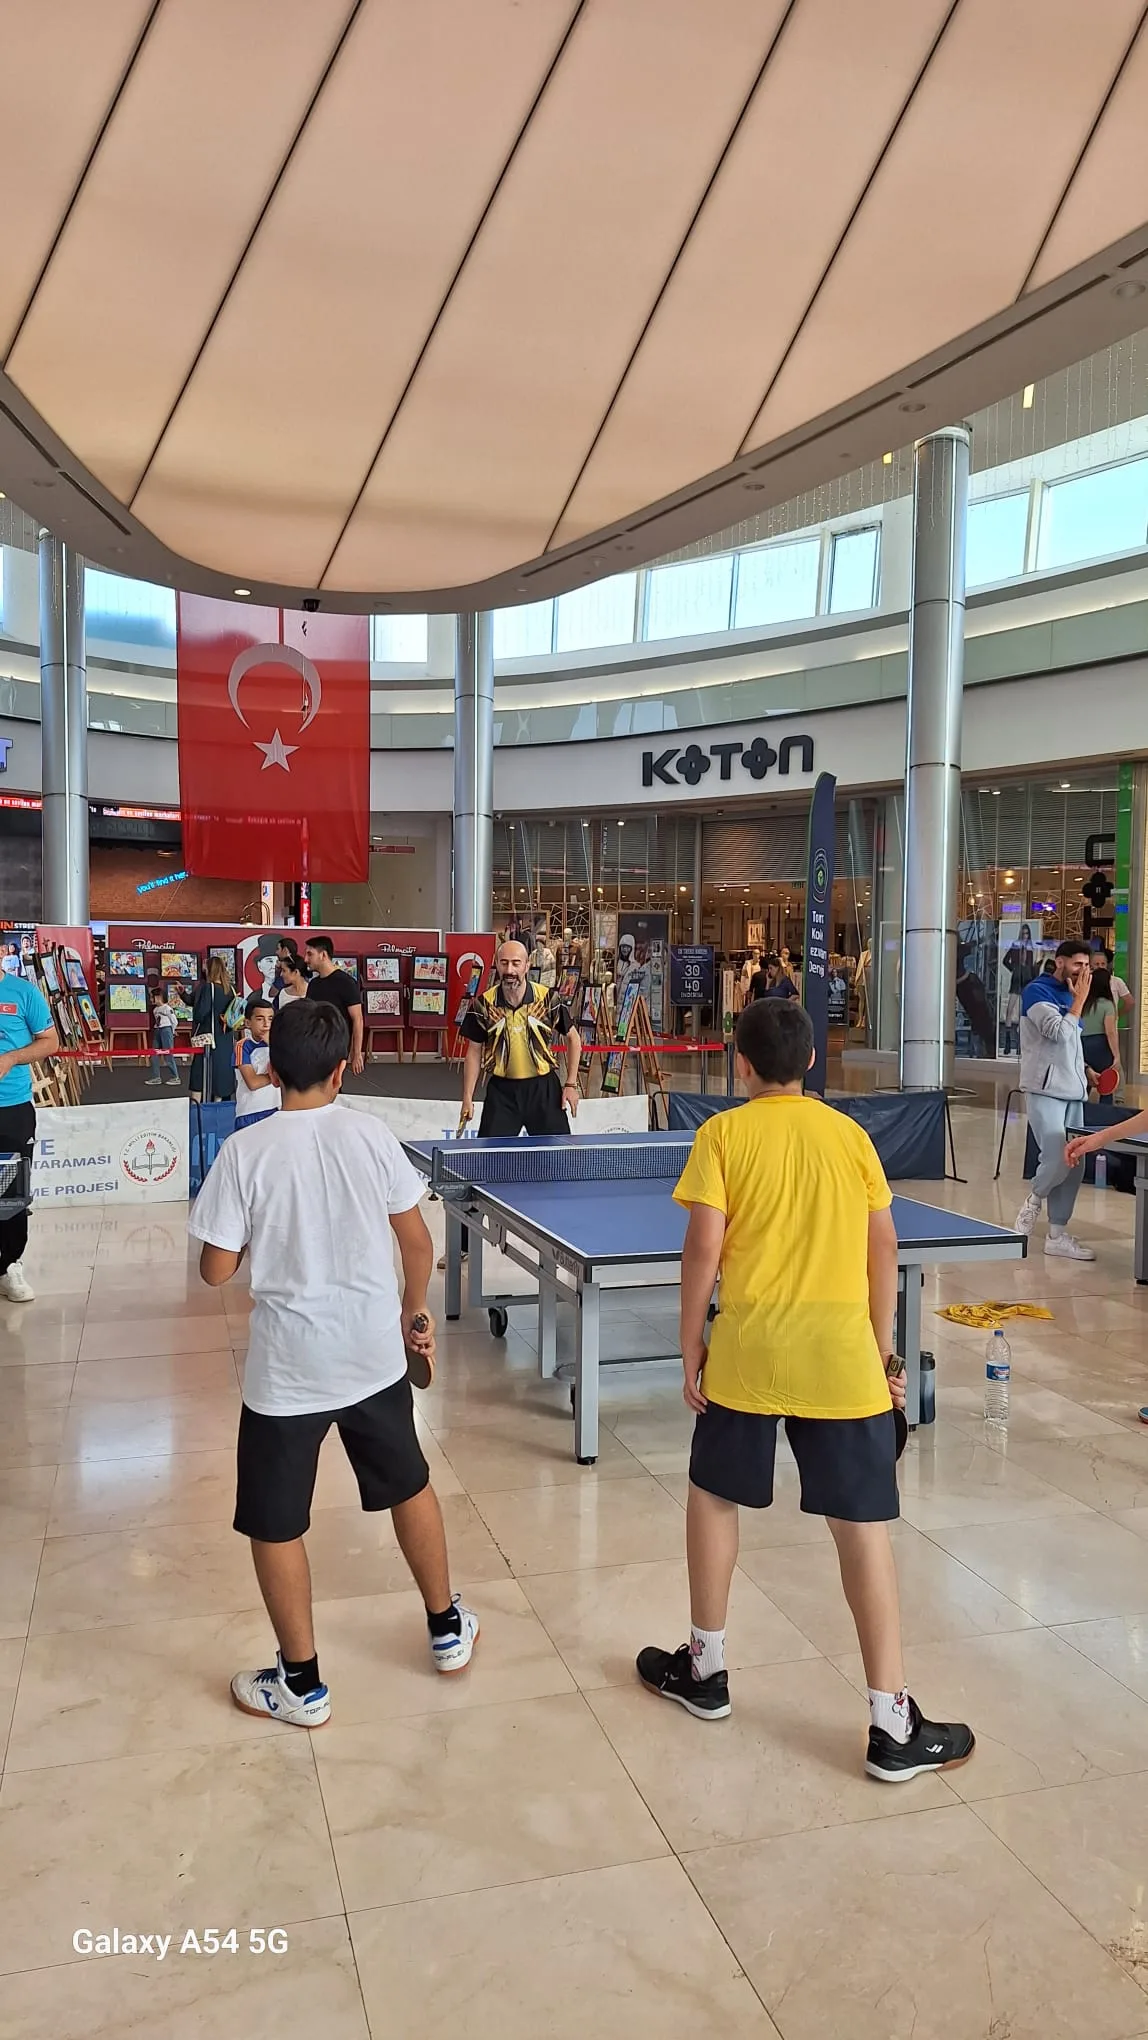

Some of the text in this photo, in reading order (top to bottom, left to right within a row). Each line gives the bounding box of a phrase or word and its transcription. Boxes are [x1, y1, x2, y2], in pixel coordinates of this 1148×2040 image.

[684, 964, 700, 977] 30
[684, 979, 700, 992] 40
[33, 1155, 111, 1170] TARAMASI
[55, 1179, 119, 1196] PROJESİ
